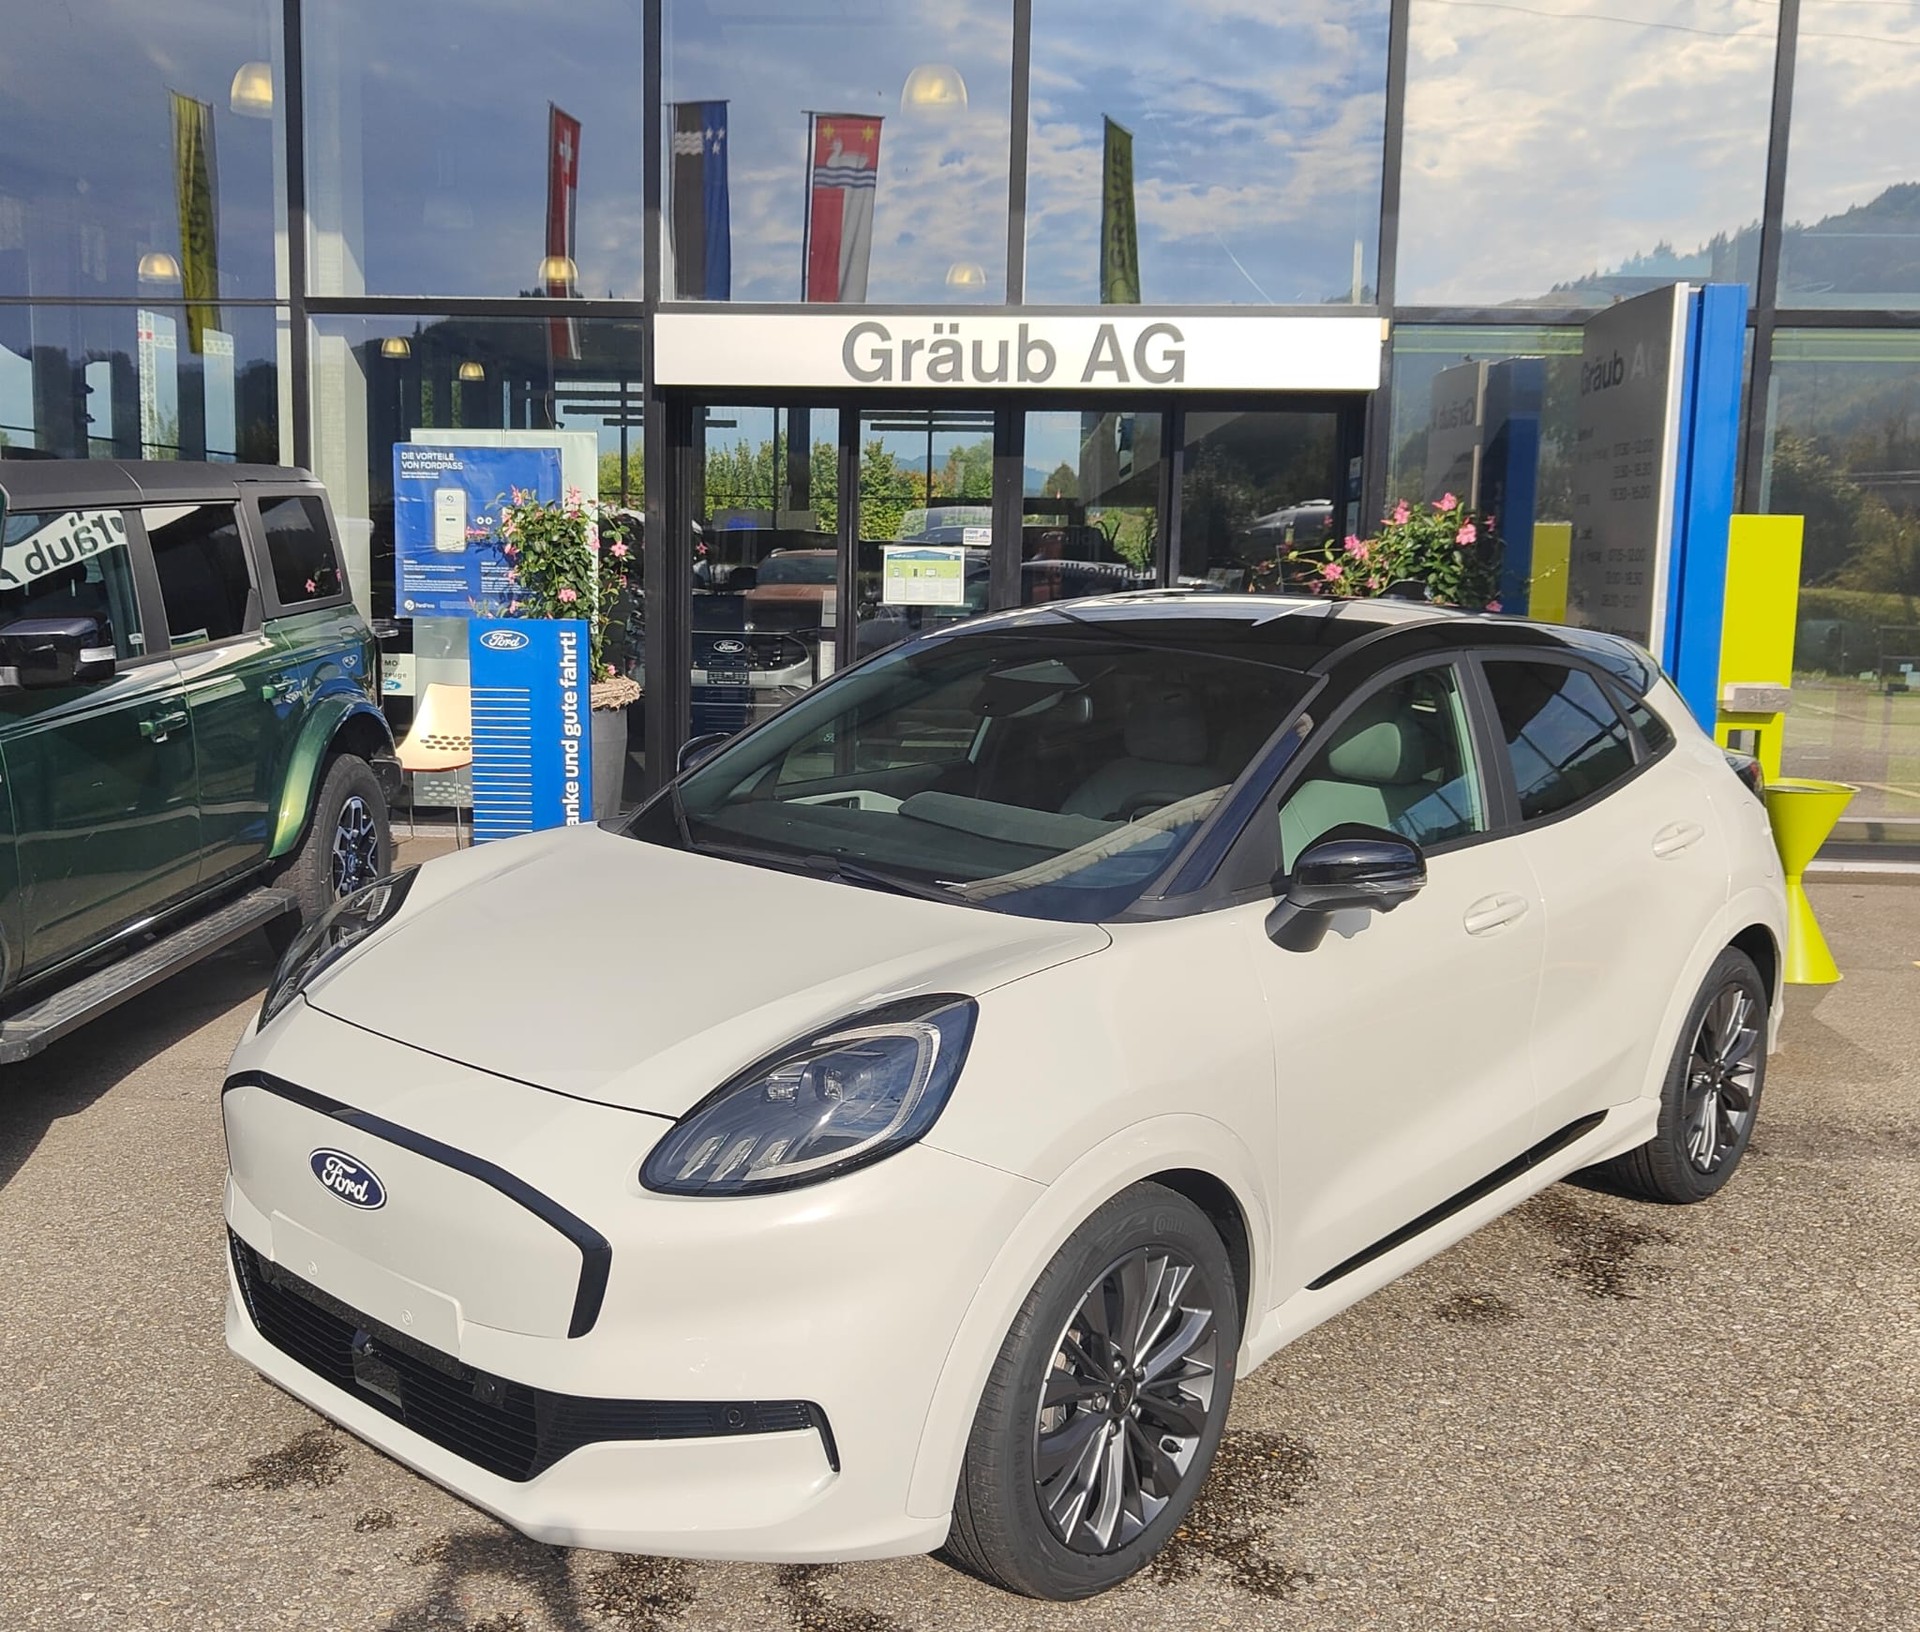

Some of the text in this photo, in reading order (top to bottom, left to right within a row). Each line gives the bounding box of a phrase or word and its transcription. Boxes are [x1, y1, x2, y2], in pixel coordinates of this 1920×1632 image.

[842, 320, 1186, 385] Gräub AG
[401, 452, 455, 461] DIE VORTEILE
[401, 461, 464, 470] VON FORDPASS
[489, 632, 520, 647] Ford
[719, 641, 740, 650] Ford
[559, 631, 578, 688] fahrt!
[561, 691, 582, 737] gute
[560, 740, 579, 778] und
[322, 1156, 369, 1202] Ford
